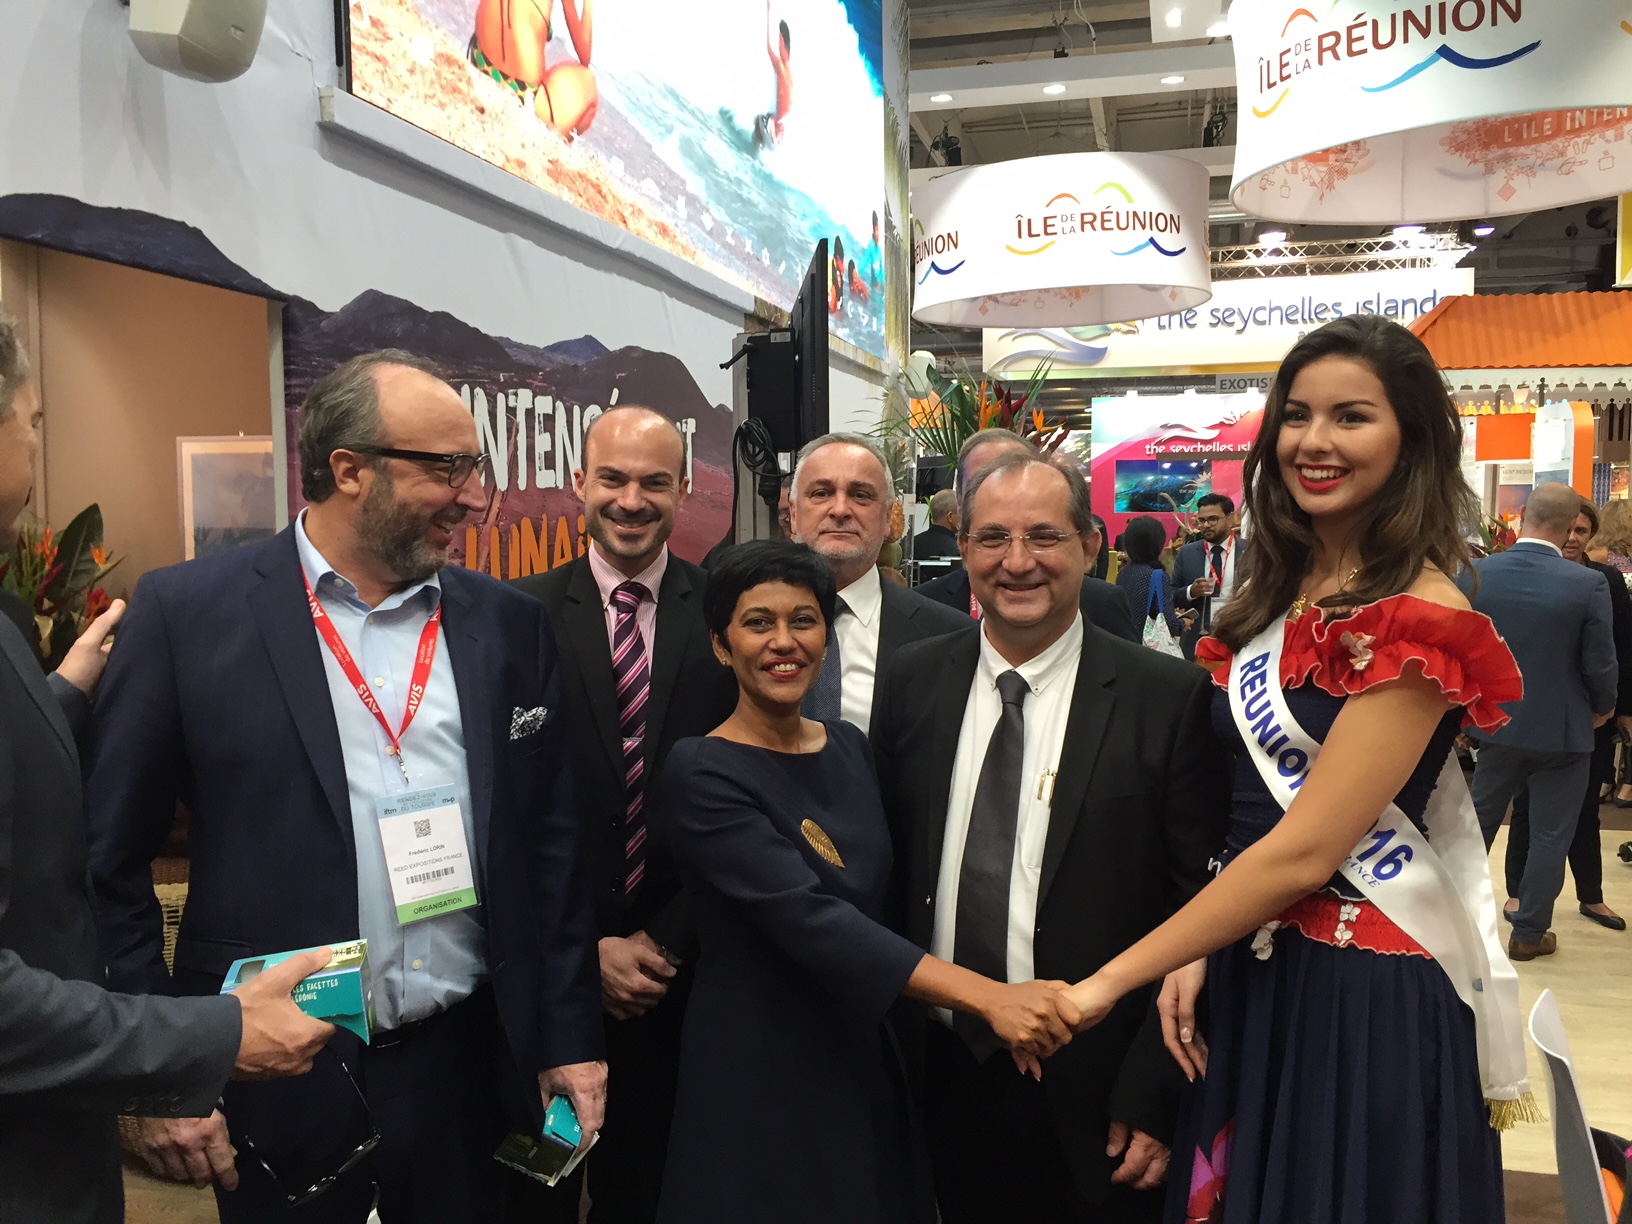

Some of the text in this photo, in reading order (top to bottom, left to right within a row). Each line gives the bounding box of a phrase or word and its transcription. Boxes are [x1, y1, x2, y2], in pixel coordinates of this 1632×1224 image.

[1258, 0, 1523, 94] ÎLE DE LA RÉUNION
[1015, 213, 1058, 240] ÎLE
[1060, 213, 1077, 223] DE
[1079, 205, 1182, 235] RÉUNION
[1061, 226, 1077, 235] LA
[914, 231, 959, 265] ÉUNION
[1209, 296, 1344, 335] seychelles
[1356, 289, 1448, 320] island
[1220, 377, 1273, 391] EXOTIS
[1145, 441, 1251, 455] the seychelles isl
[357, 683, 381, 714] AVIS
[408, 683, 423, 716] AVIS
[429, 843, 446, 852] LORIN
[408, 856, 444, 869] EXPOSITIONS
[443, 851, 464, 861] FRANCE
[1345, 855, 1381, 889] RANCE
[413, 896, 463, 915] ORGANISATION
[306, 978, 339, 992] FACETTES
